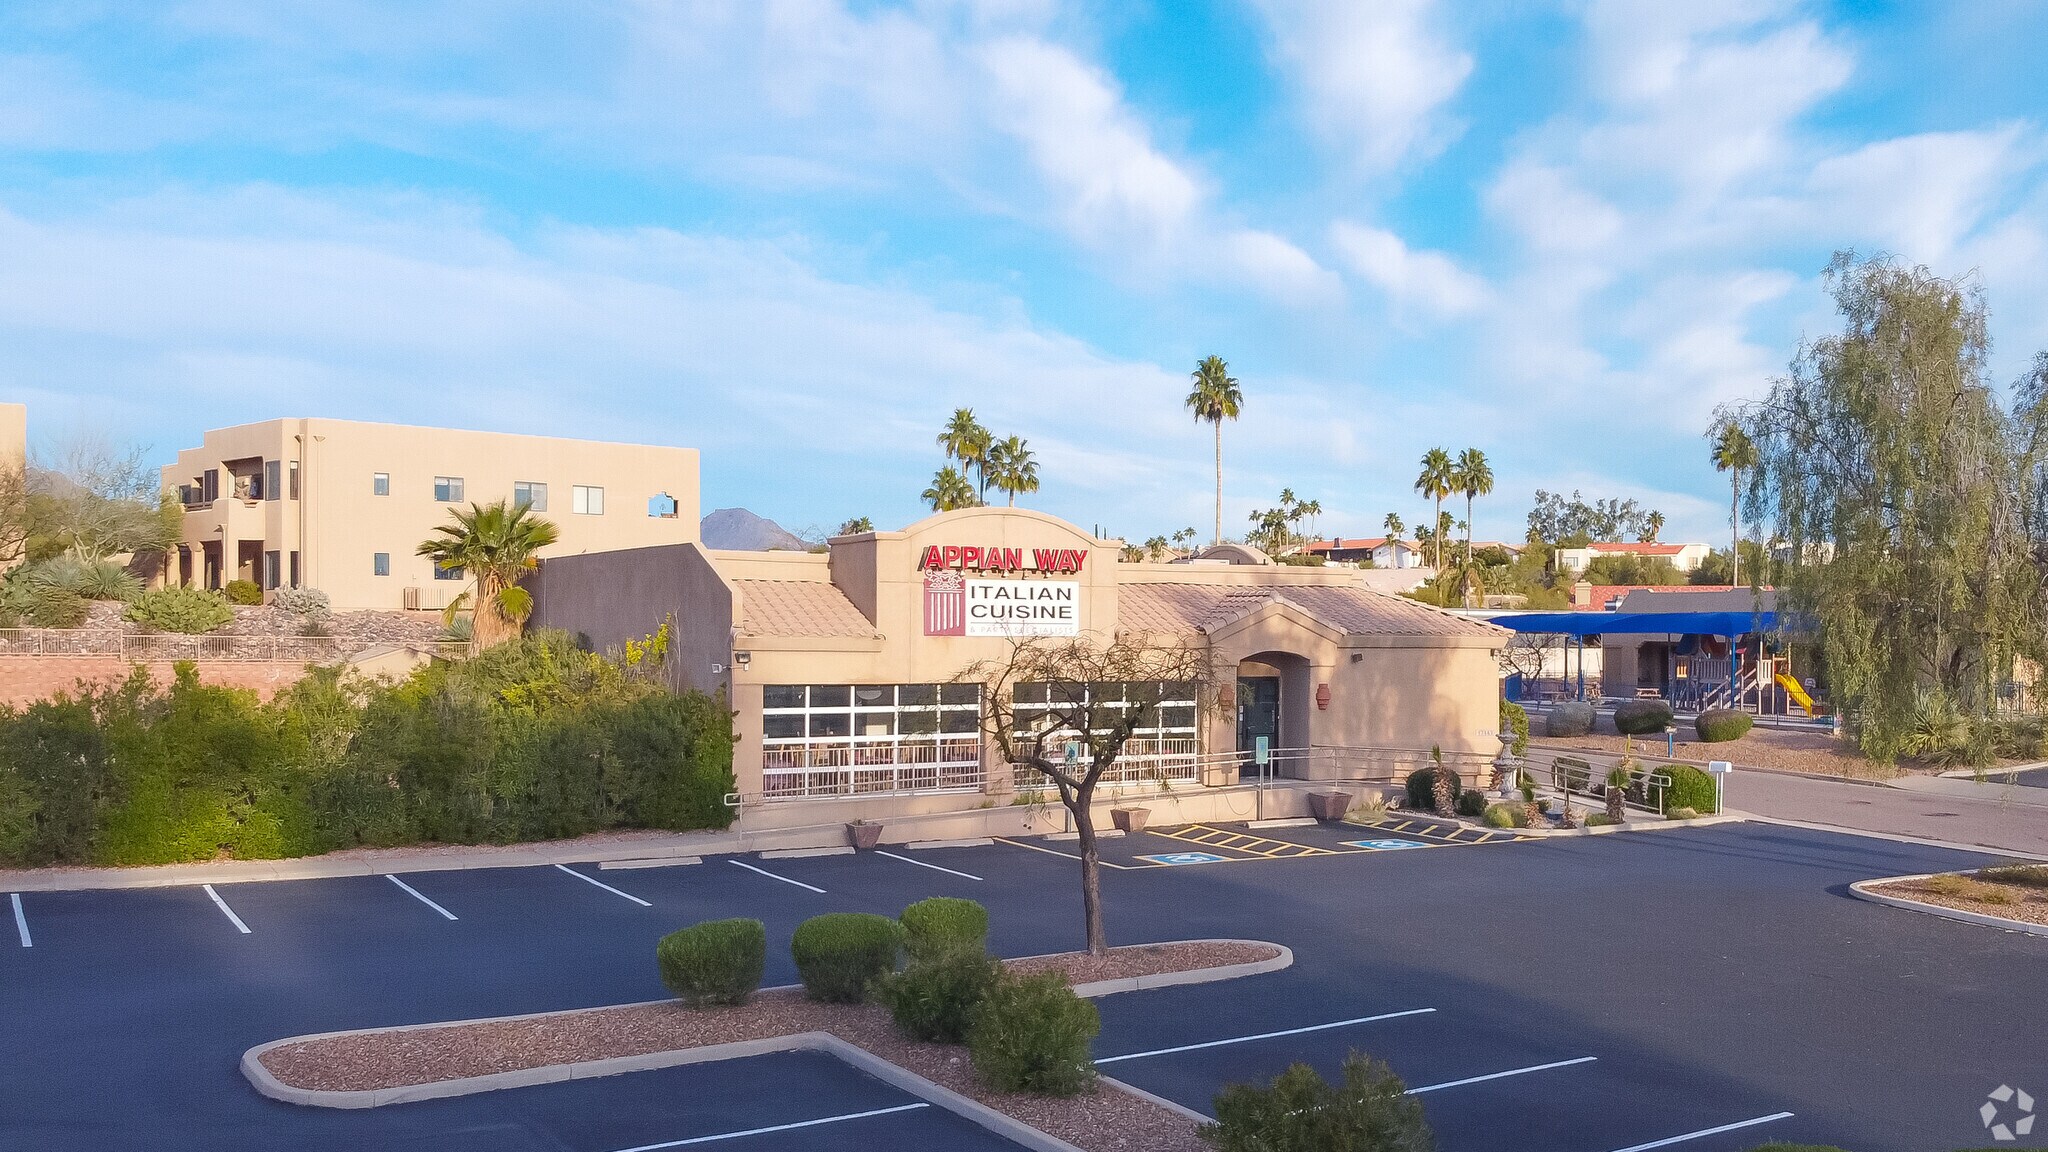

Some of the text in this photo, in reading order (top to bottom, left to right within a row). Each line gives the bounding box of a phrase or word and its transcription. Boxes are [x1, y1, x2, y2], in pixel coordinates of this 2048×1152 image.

[923, 545, 1088, 571] APPIAN WAY
[970, 586, 1072, 601] ITALIAN
[970, 604, 1073, 619] CUISINE
